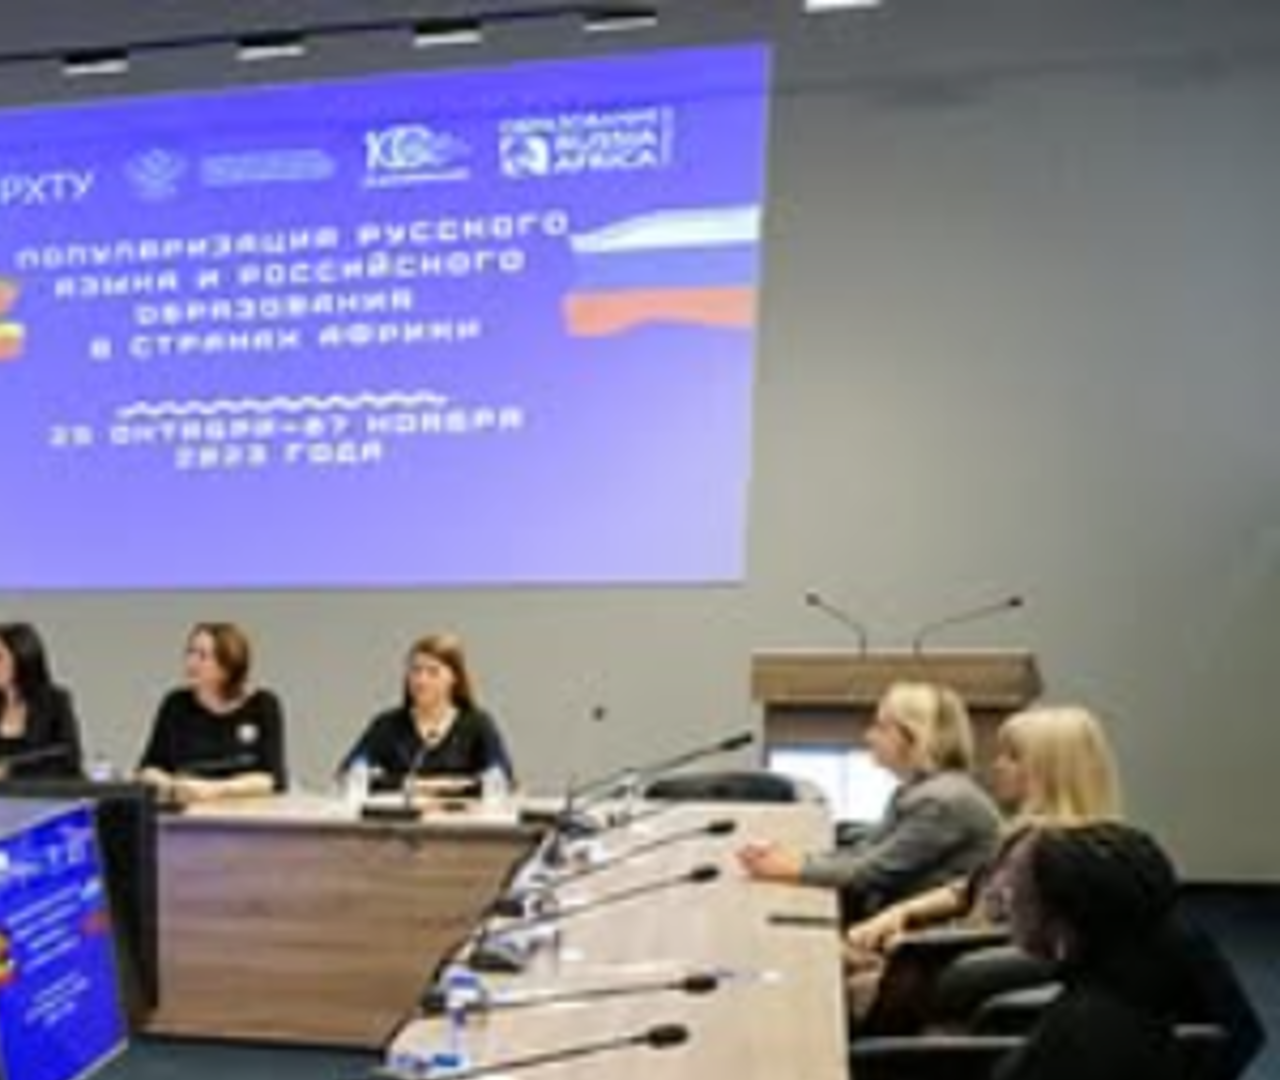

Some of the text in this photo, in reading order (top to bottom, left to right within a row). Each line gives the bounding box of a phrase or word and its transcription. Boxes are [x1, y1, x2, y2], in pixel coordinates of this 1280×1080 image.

[0, 169, 94, 206] РХТУ
[357, 209, 568, 247] РУССКОГО
[198, 266, 220, 290] И
[238, 250, 525, 286] РОССИЙСКОГО
[136, 288, 413, 325] ОБРАЗОВАНИЯ
[90, 318, 481, 360] В СТРАНАХ АФРИКИ
[367, 407, 524, 434] НОЯБРЯ
